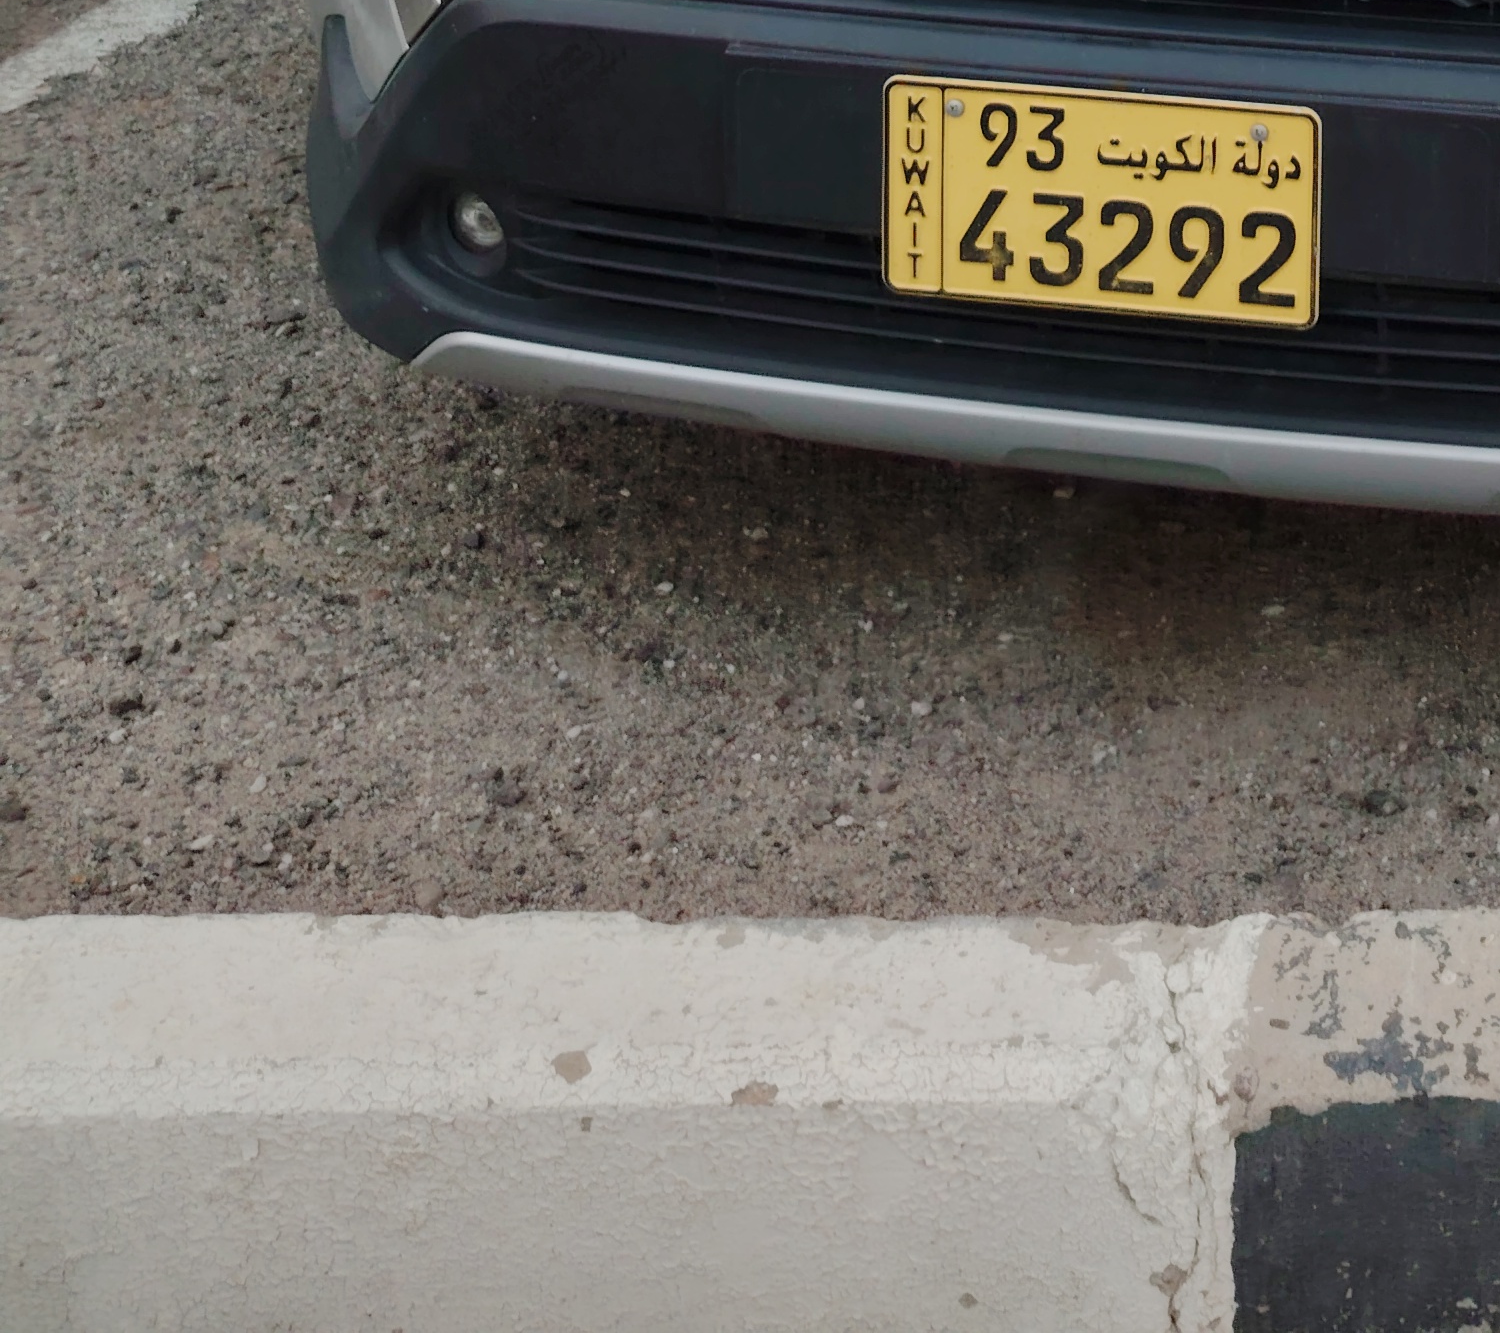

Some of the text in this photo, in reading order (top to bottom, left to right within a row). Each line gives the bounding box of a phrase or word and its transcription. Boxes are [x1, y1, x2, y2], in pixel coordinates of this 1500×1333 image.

[979, 102, 1066, 172] 93
[1097, 133, 1302, 190] دولة الكويت
[901, 95, 931, 280] KUWAIT
[958, 189, 1297, 309] 43292
